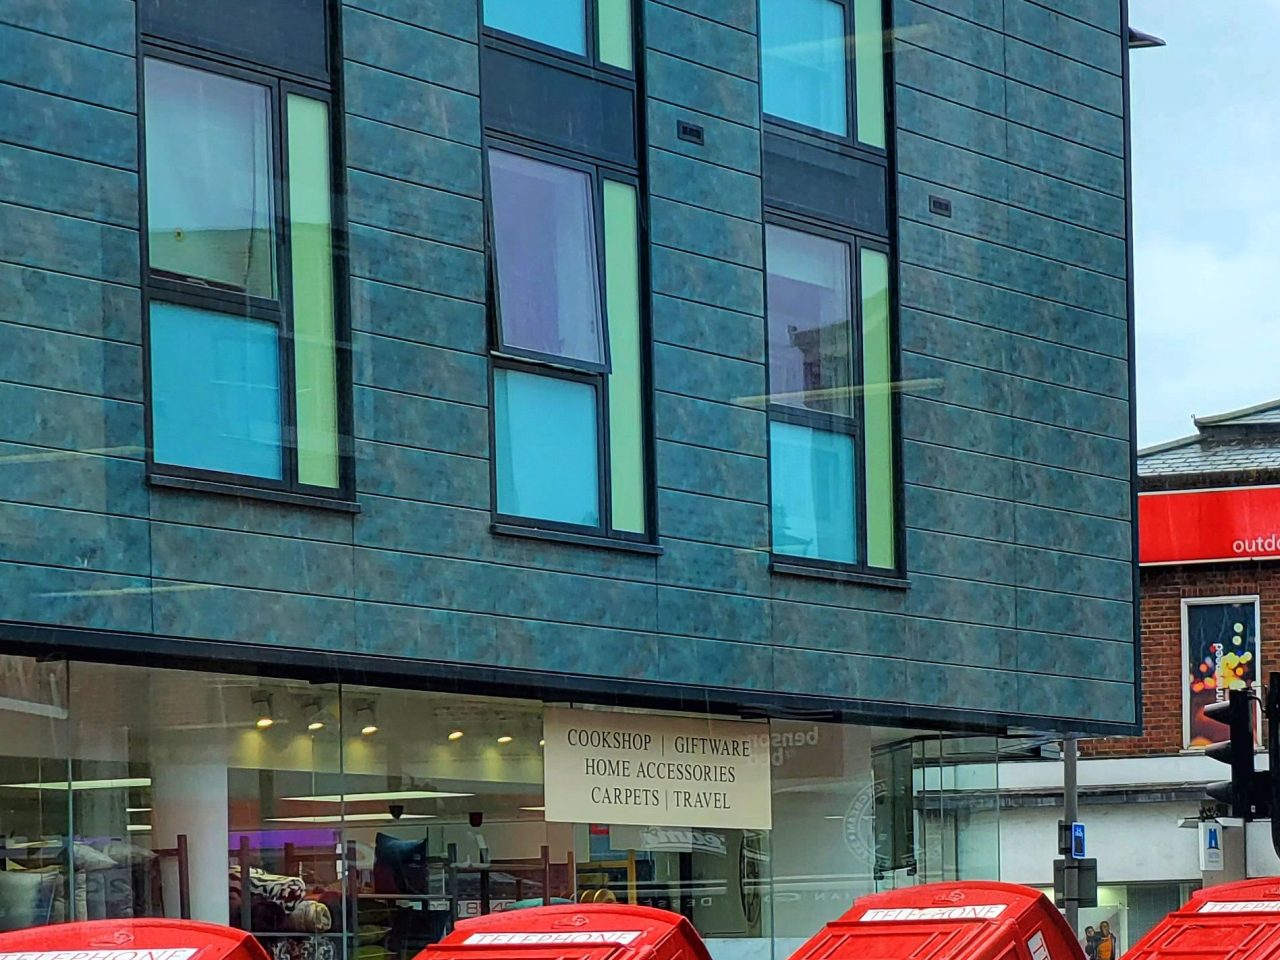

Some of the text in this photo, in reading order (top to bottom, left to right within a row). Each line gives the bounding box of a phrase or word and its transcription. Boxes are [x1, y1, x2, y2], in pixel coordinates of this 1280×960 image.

[567, 728, 750, 757] COOKSHOP GIFTWARE
[584, 757, 736, 783] HOME ACCESSORIES
[591, 786, 731, 810] CARPETS TRAVEL
